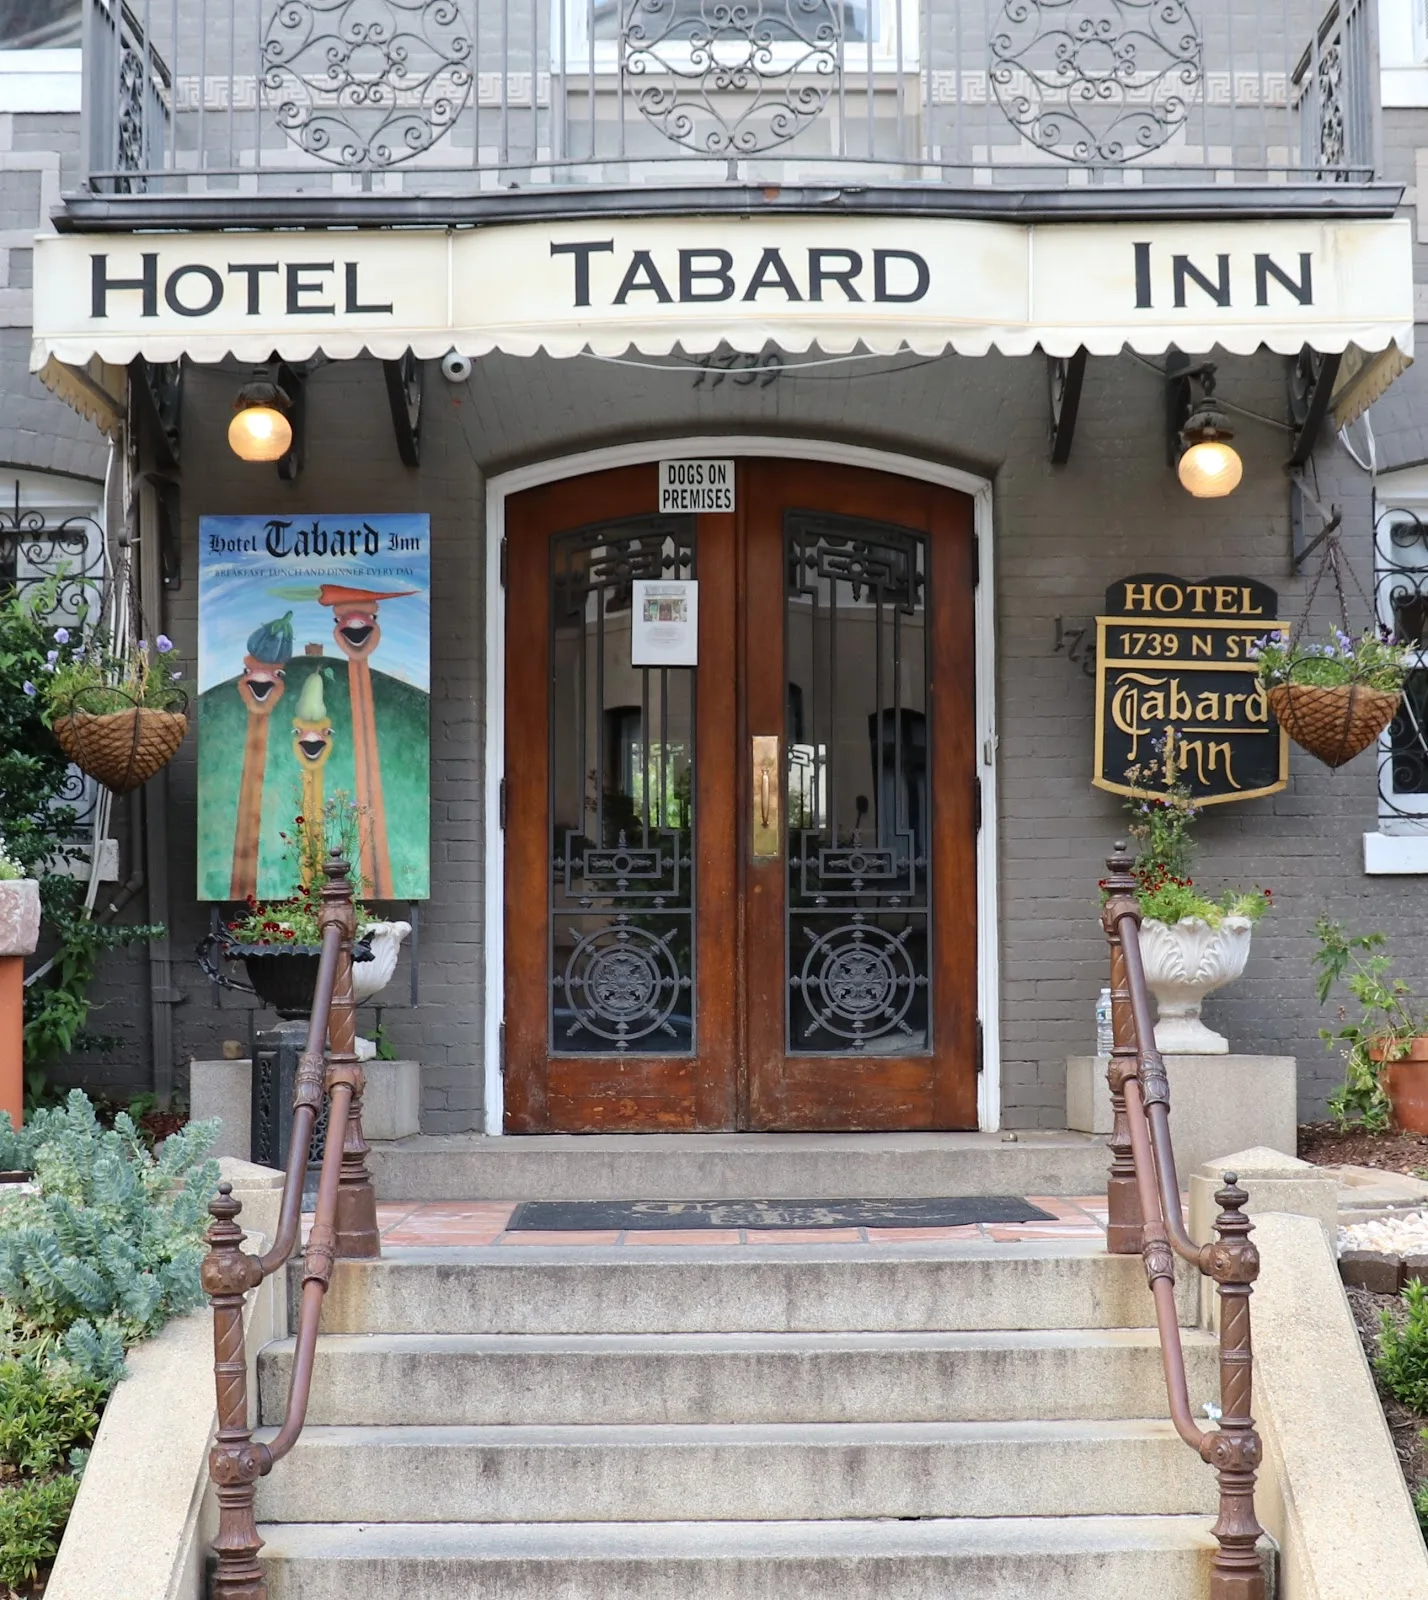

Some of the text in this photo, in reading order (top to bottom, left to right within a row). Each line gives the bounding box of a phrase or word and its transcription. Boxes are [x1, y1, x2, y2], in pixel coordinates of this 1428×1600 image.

[91, 239, 1314, 318] HOTEL TABARD INN
[668, 464, 726, 484] DOGS ON
[662, 488, 732, 509] PREMISES
[208, 520, 421, 558] Hotel Tabard Inn
[269, 567, 302, 577] LUNCH
[304, 567, 325, 577] AND
[327, 567, 363, 576] DINNER
[366, 567, 393, 576] EVERY
[396, 567, 414, 576] DAY
[1123, 583, 1264, 615] HOTEL
[1119, 633, 1179, 656] 1739
[1191, 635, 1213, 656] N
[1111, 672, 1269, 761] Tabard
[1161, 724, 1241, 789] Inn
